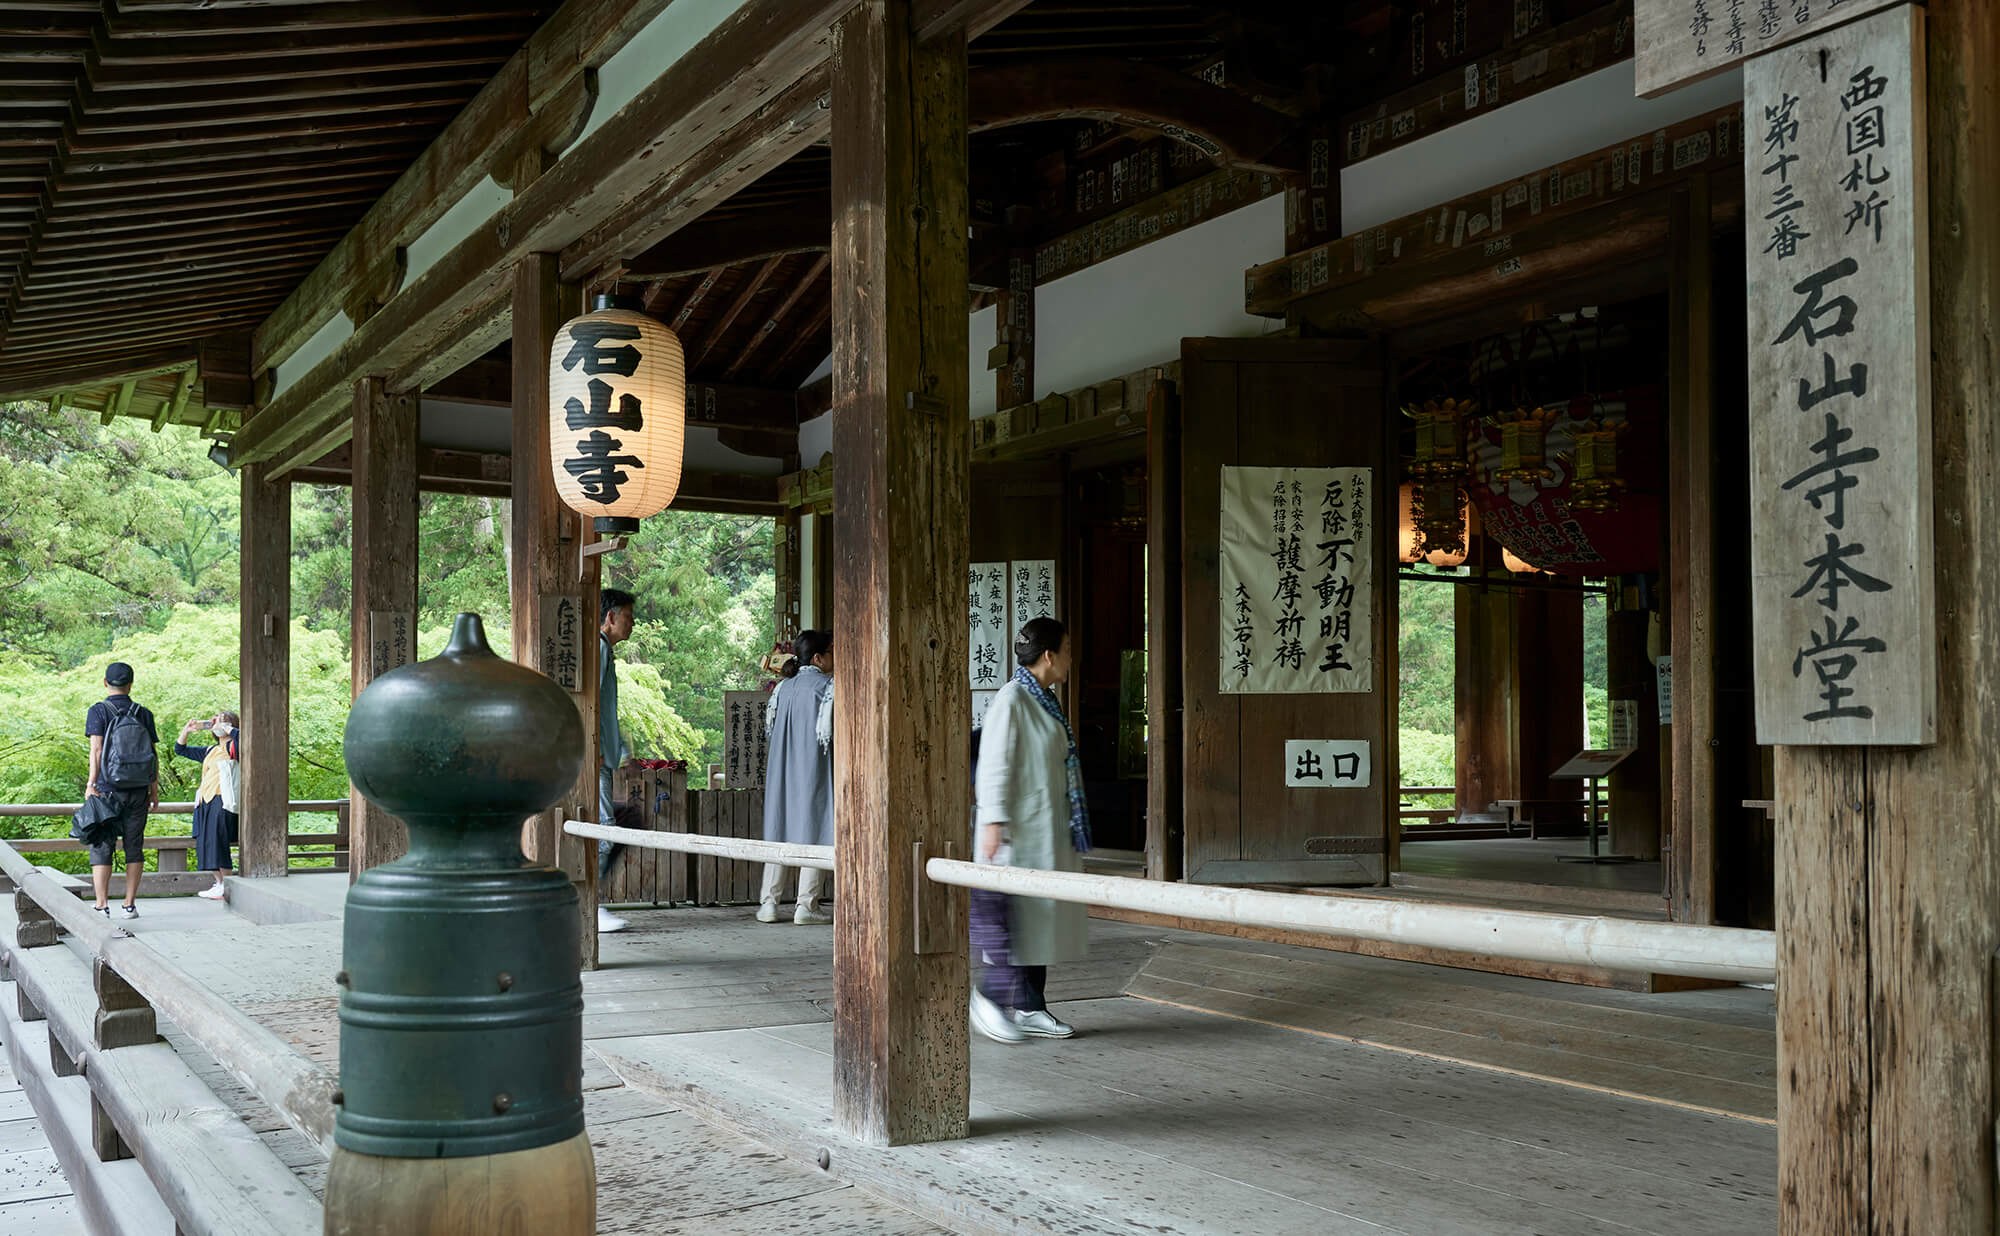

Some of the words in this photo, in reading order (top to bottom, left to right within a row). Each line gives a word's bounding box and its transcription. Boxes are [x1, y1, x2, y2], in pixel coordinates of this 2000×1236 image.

[1762, 93, 1811, 260] 第十三番
[1839, 65, 1891, 243] 西国札所
[561, 321, 645, 504] 石山寺
[1273, 481, 1287, 533] 厄除招福
[1290, 480, 1304, 532] 家内安全
[1771, 257, 1893, 721] 石山寺本堂
[987, 568, 1002, 630] 安産御守
[1312, 481, 1355, 673] 厄除不動明王
[557, 598, 577, 689] たばこ禁止
[1233, 582, 1254, 678] 大本山石山寺
[1295, 750, 1360, 781] 出口
